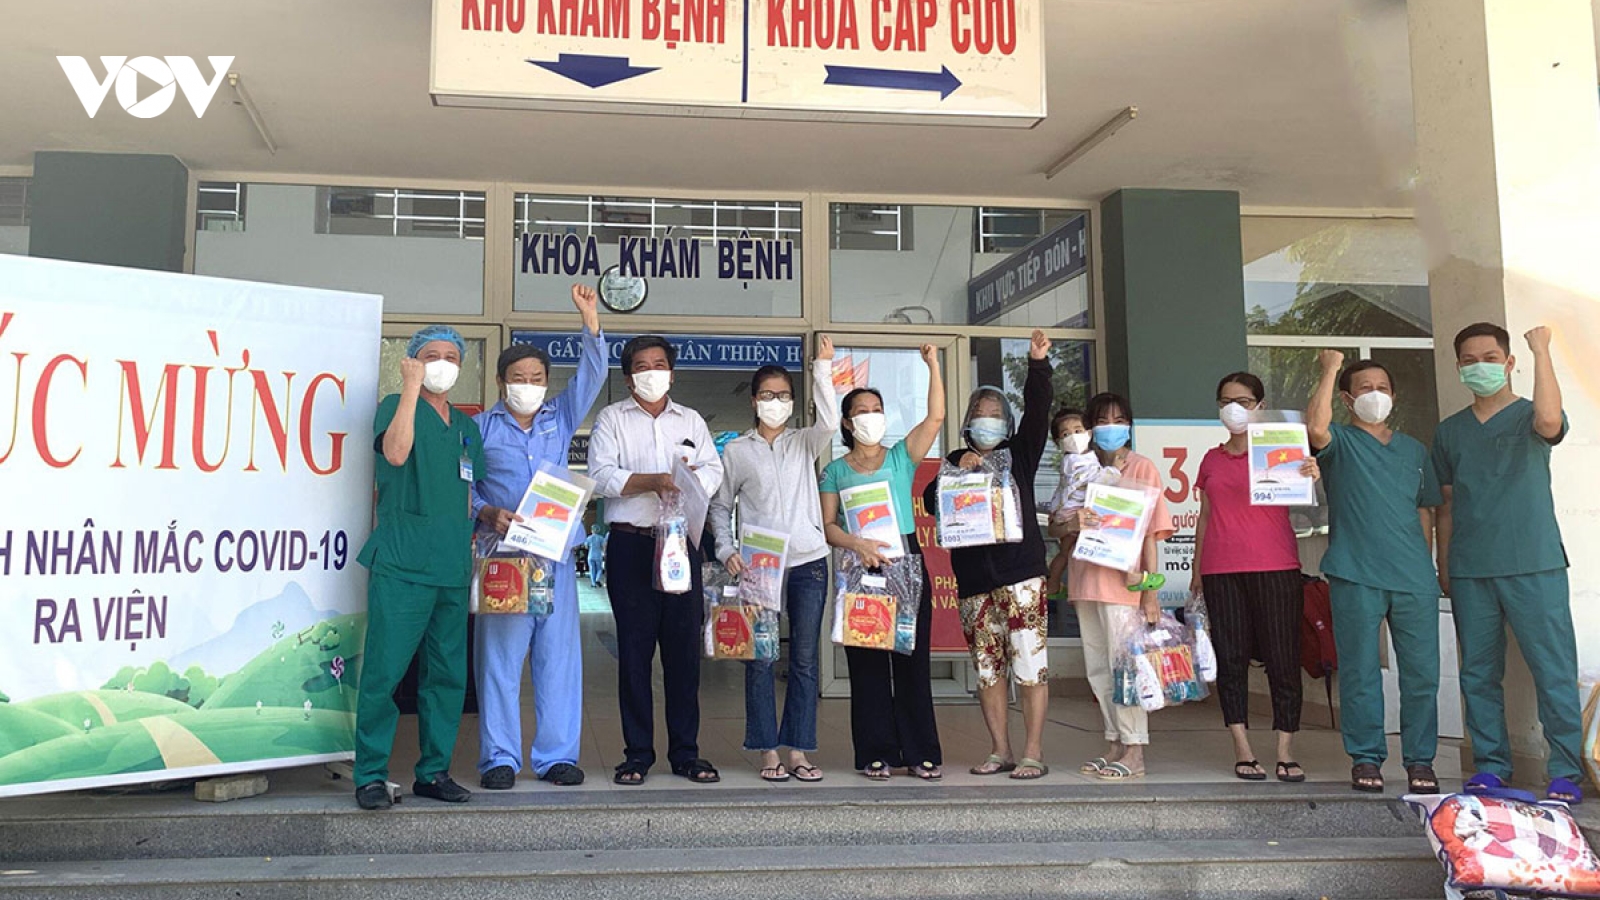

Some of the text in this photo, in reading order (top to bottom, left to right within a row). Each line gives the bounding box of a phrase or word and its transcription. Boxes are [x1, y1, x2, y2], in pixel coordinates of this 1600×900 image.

[521, 226, 793, 290] KHOA KHÁM BỆNH
[975, 282, 994, 315] KHU
[995, 268, 1015, 305] VỰC
[1017, 250, 1040, 291] TIẾP
[1044, 237, 1070, 277] ĐÓN
[670, 340, 713, 361] HÂN
[717, 341, 780, 365] THIỆN
[110, 330, 349, 475] MỪNG
[1163, 447, 1189, 503] 3
[1254, 492, 1271, 501] 994
[24, 517, 123, 576] NHÂN
[133, 520, 204, 574] MẮC
[214, 529, 348, 573] COVID-19
[1078, 545, 1094, 556] 629
[33, 589, 168, 651] RA VIỆN
